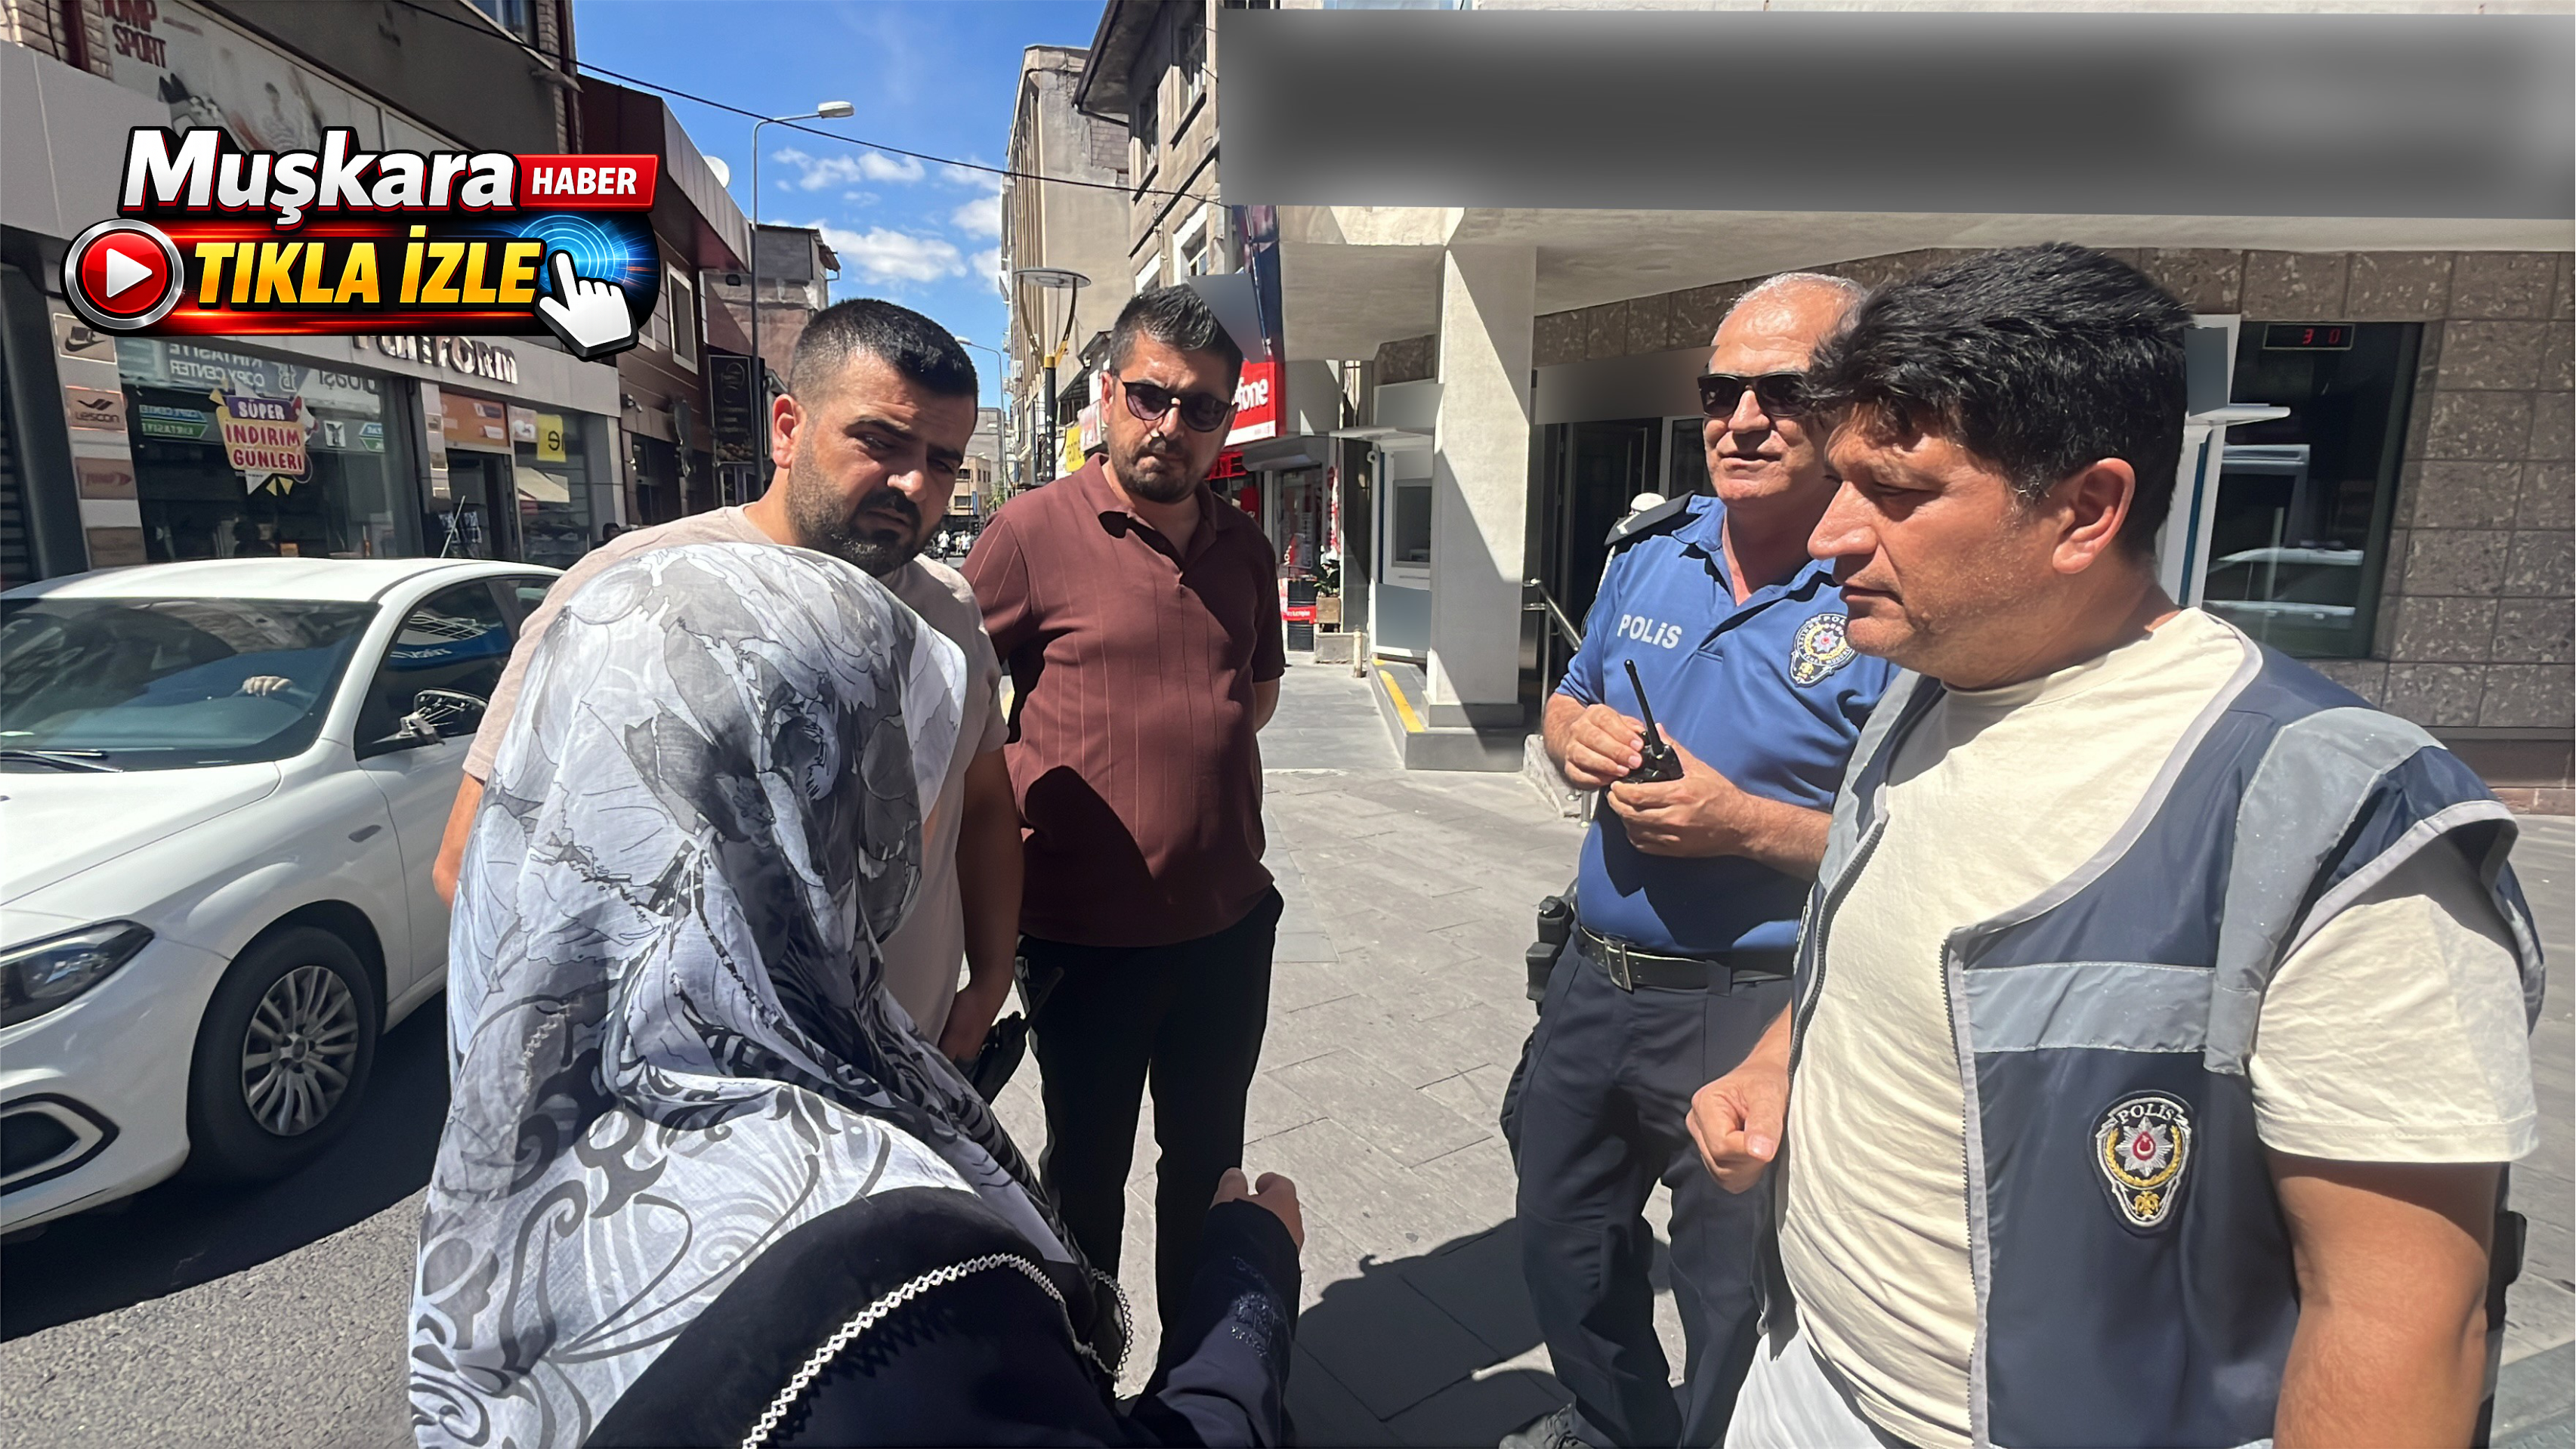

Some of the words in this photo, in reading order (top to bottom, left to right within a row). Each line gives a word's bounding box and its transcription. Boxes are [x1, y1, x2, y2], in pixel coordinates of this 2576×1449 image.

[112, 23, 167, 69] SPORT
[238, 399, 286, 421] SÜPER
[2118, 1103, 2175, 1124] POLİS
